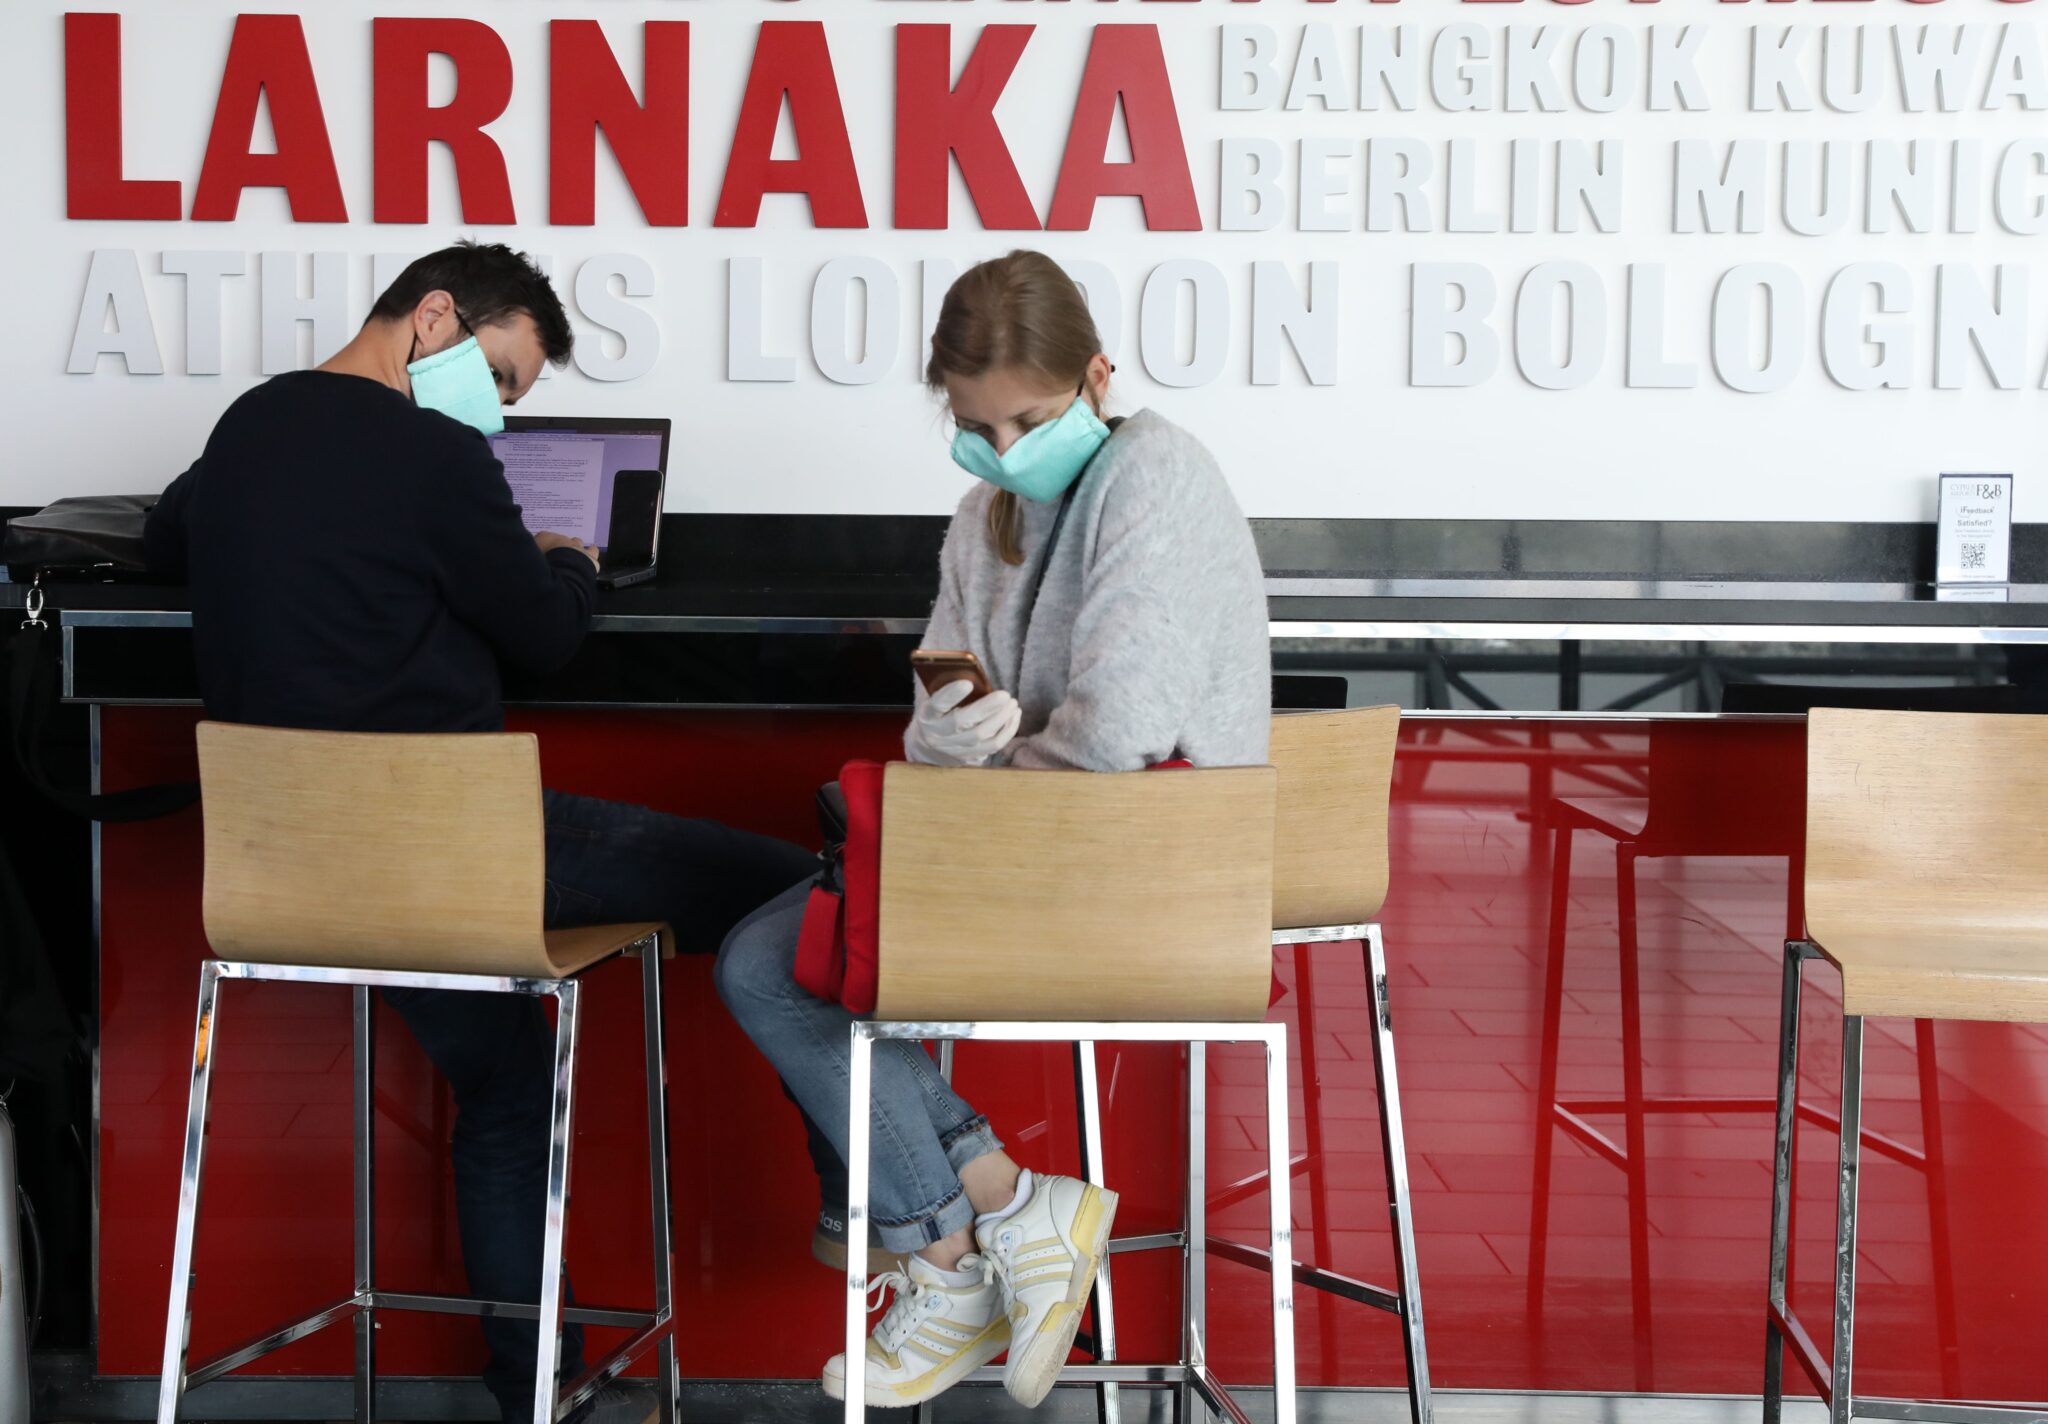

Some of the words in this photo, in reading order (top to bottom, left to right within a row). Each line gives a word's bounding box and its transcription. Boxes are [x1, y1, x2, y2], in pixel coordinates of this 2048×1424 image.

[1219, 23, 1710, 113] BANGKOK
[65, 12, 1201, 231] LARNAKA
[1218, 138, 1624, 233] BERLIN
[66, 249, 660, 382] ATHS
[728, 256, 1340, 388] LOON
[1409, 261, 2048, 393] BOLOGN
[1976, 483, 2002, 499] F&B
